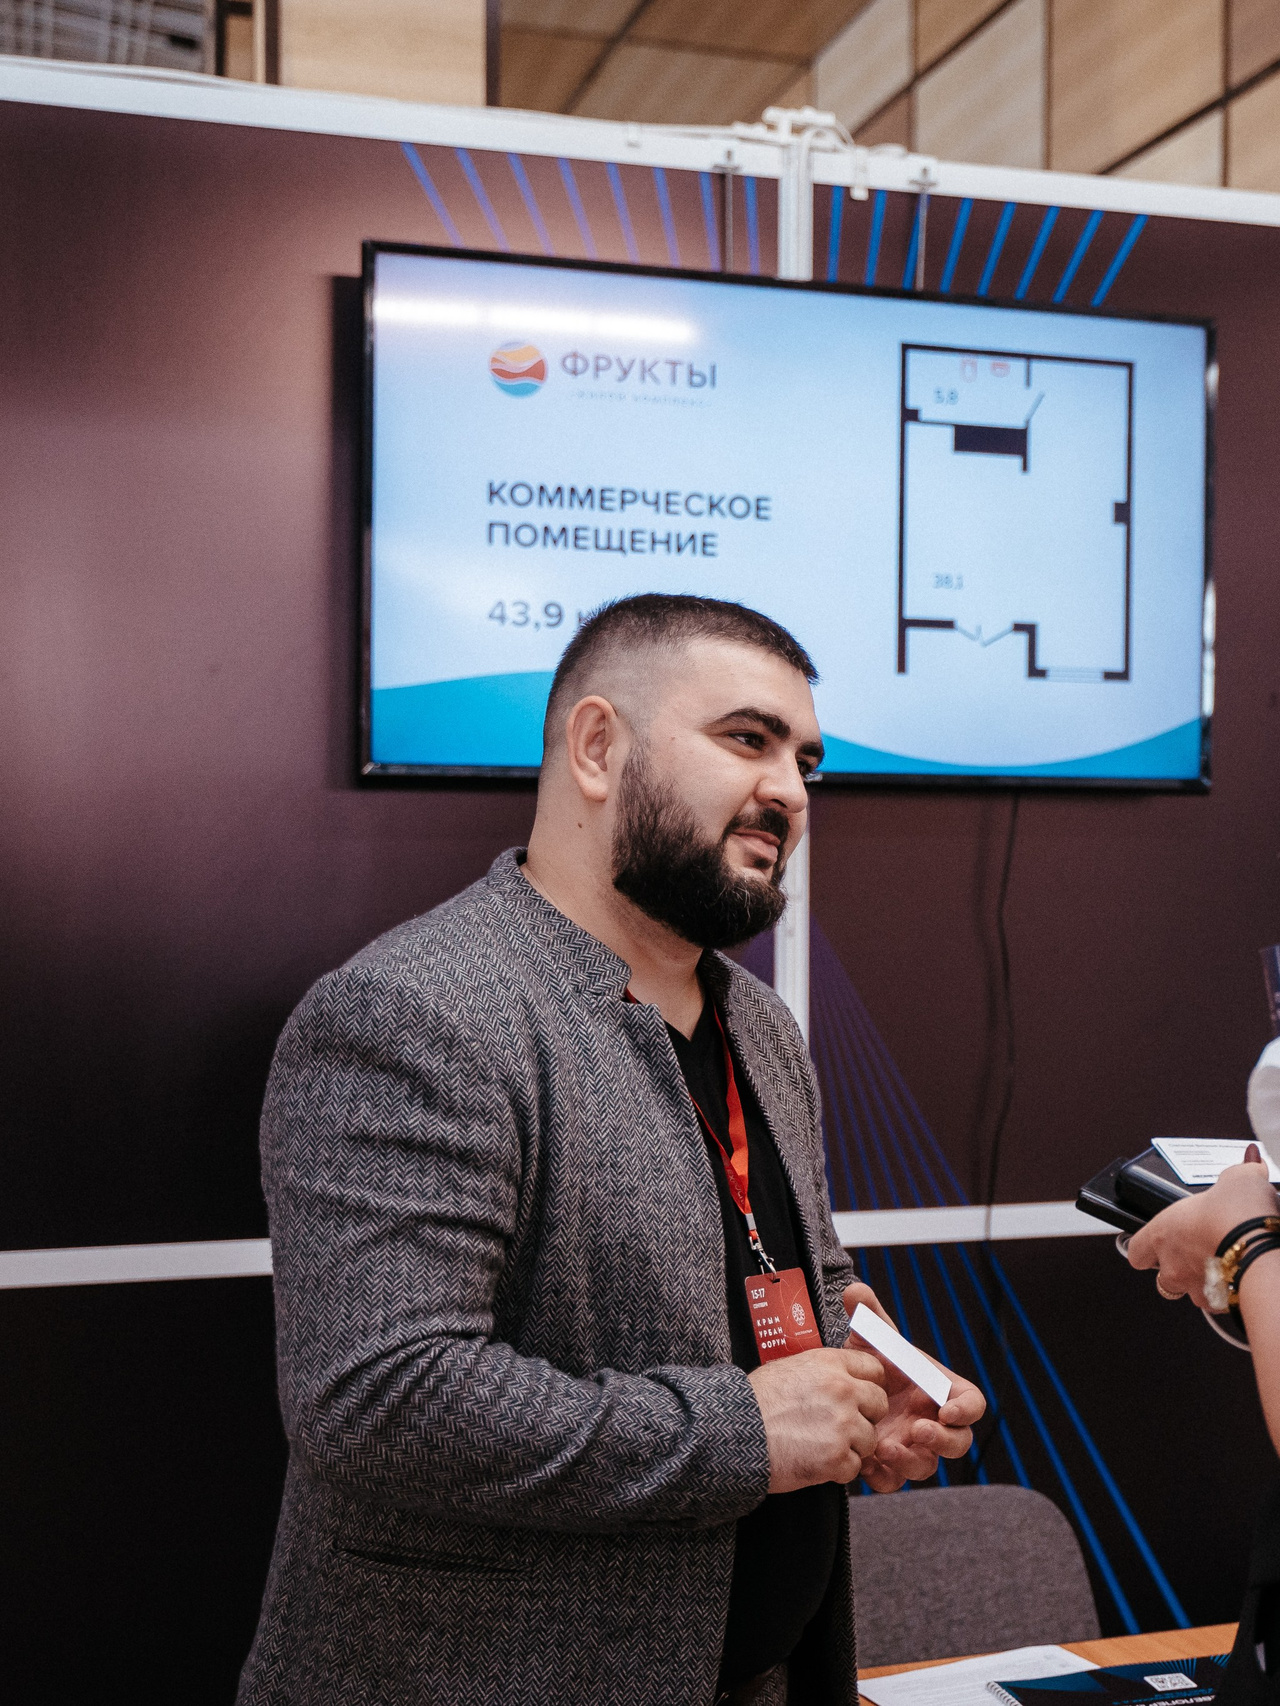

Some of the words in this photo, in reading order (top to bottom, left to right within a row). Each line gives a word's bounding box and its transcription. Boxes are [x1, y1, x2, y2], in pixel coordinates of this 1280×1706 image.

[561, 350, 718, 390] ФРУКТЫ
[488, 481, 773, 521] КОММЕРЧЕСКОЕ
[488, 521, 719, 558] ПОМЕЩЕНИЕ
[488, 600, 564, 632] 43,9
[756, 1316, 780, 1327] КРЫМ
[758, 1327, 783, 1338] УРБАН
[761, 1338, 787, 1349] ФОРУМ
